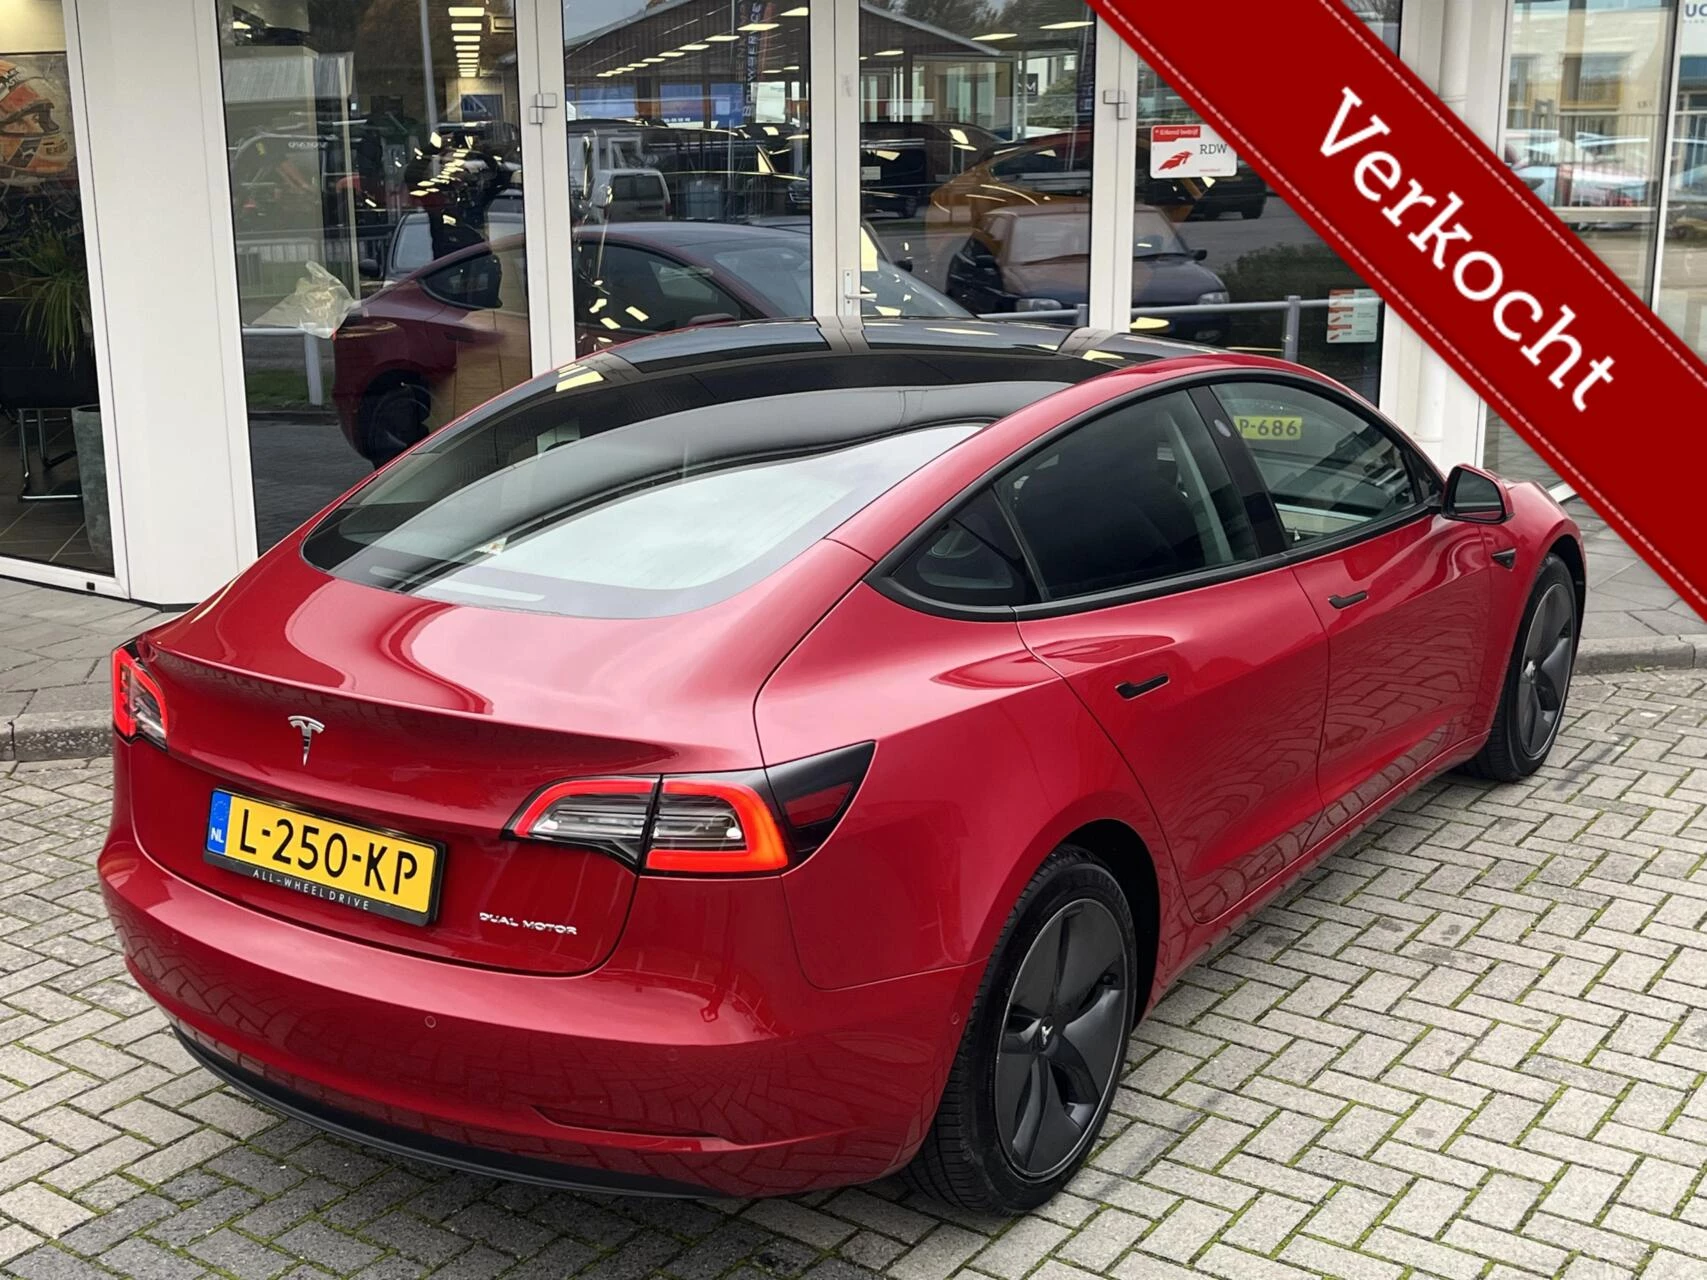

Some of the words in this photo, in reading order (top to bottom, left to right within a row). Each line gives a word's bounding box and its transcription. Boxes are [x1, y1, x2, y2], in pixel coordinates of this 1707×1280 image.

[1200, 143, 1228, 155] RDW
[1239, 419, 1298, 436] P-686
[210, 827, 225, 844] NL
[239, 808, 418, 895] L-250-KP
[252, 869, 325, 898] ALL-WHEEL
[328, 890, 370, 911] DRIVE
[479, 912, 519, 927] DUAL
[522, 920, 578, 936] MOTOR
